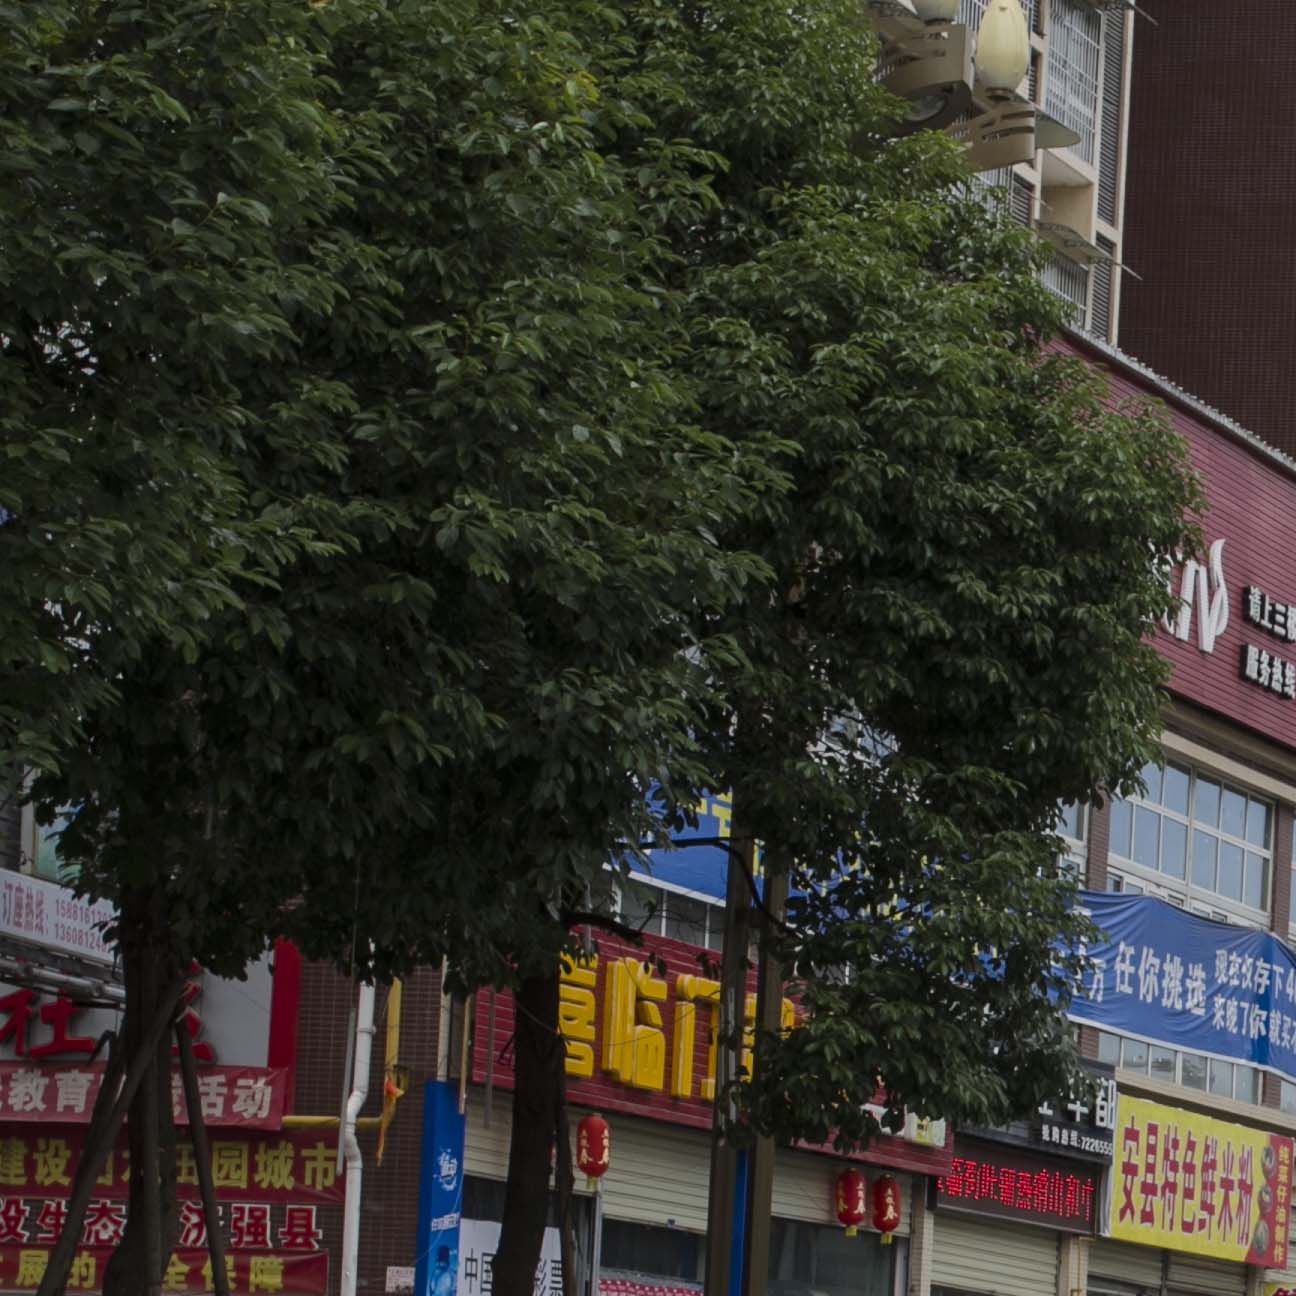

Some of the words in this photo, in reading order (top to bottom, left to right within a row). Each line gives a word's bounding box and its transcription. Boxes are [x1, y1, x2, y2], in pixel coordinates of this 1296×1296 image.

[1245, 643, 1296, 700] 服务热线
[1117, 1114, 1255, 1248] 安县特色鲜米粉
